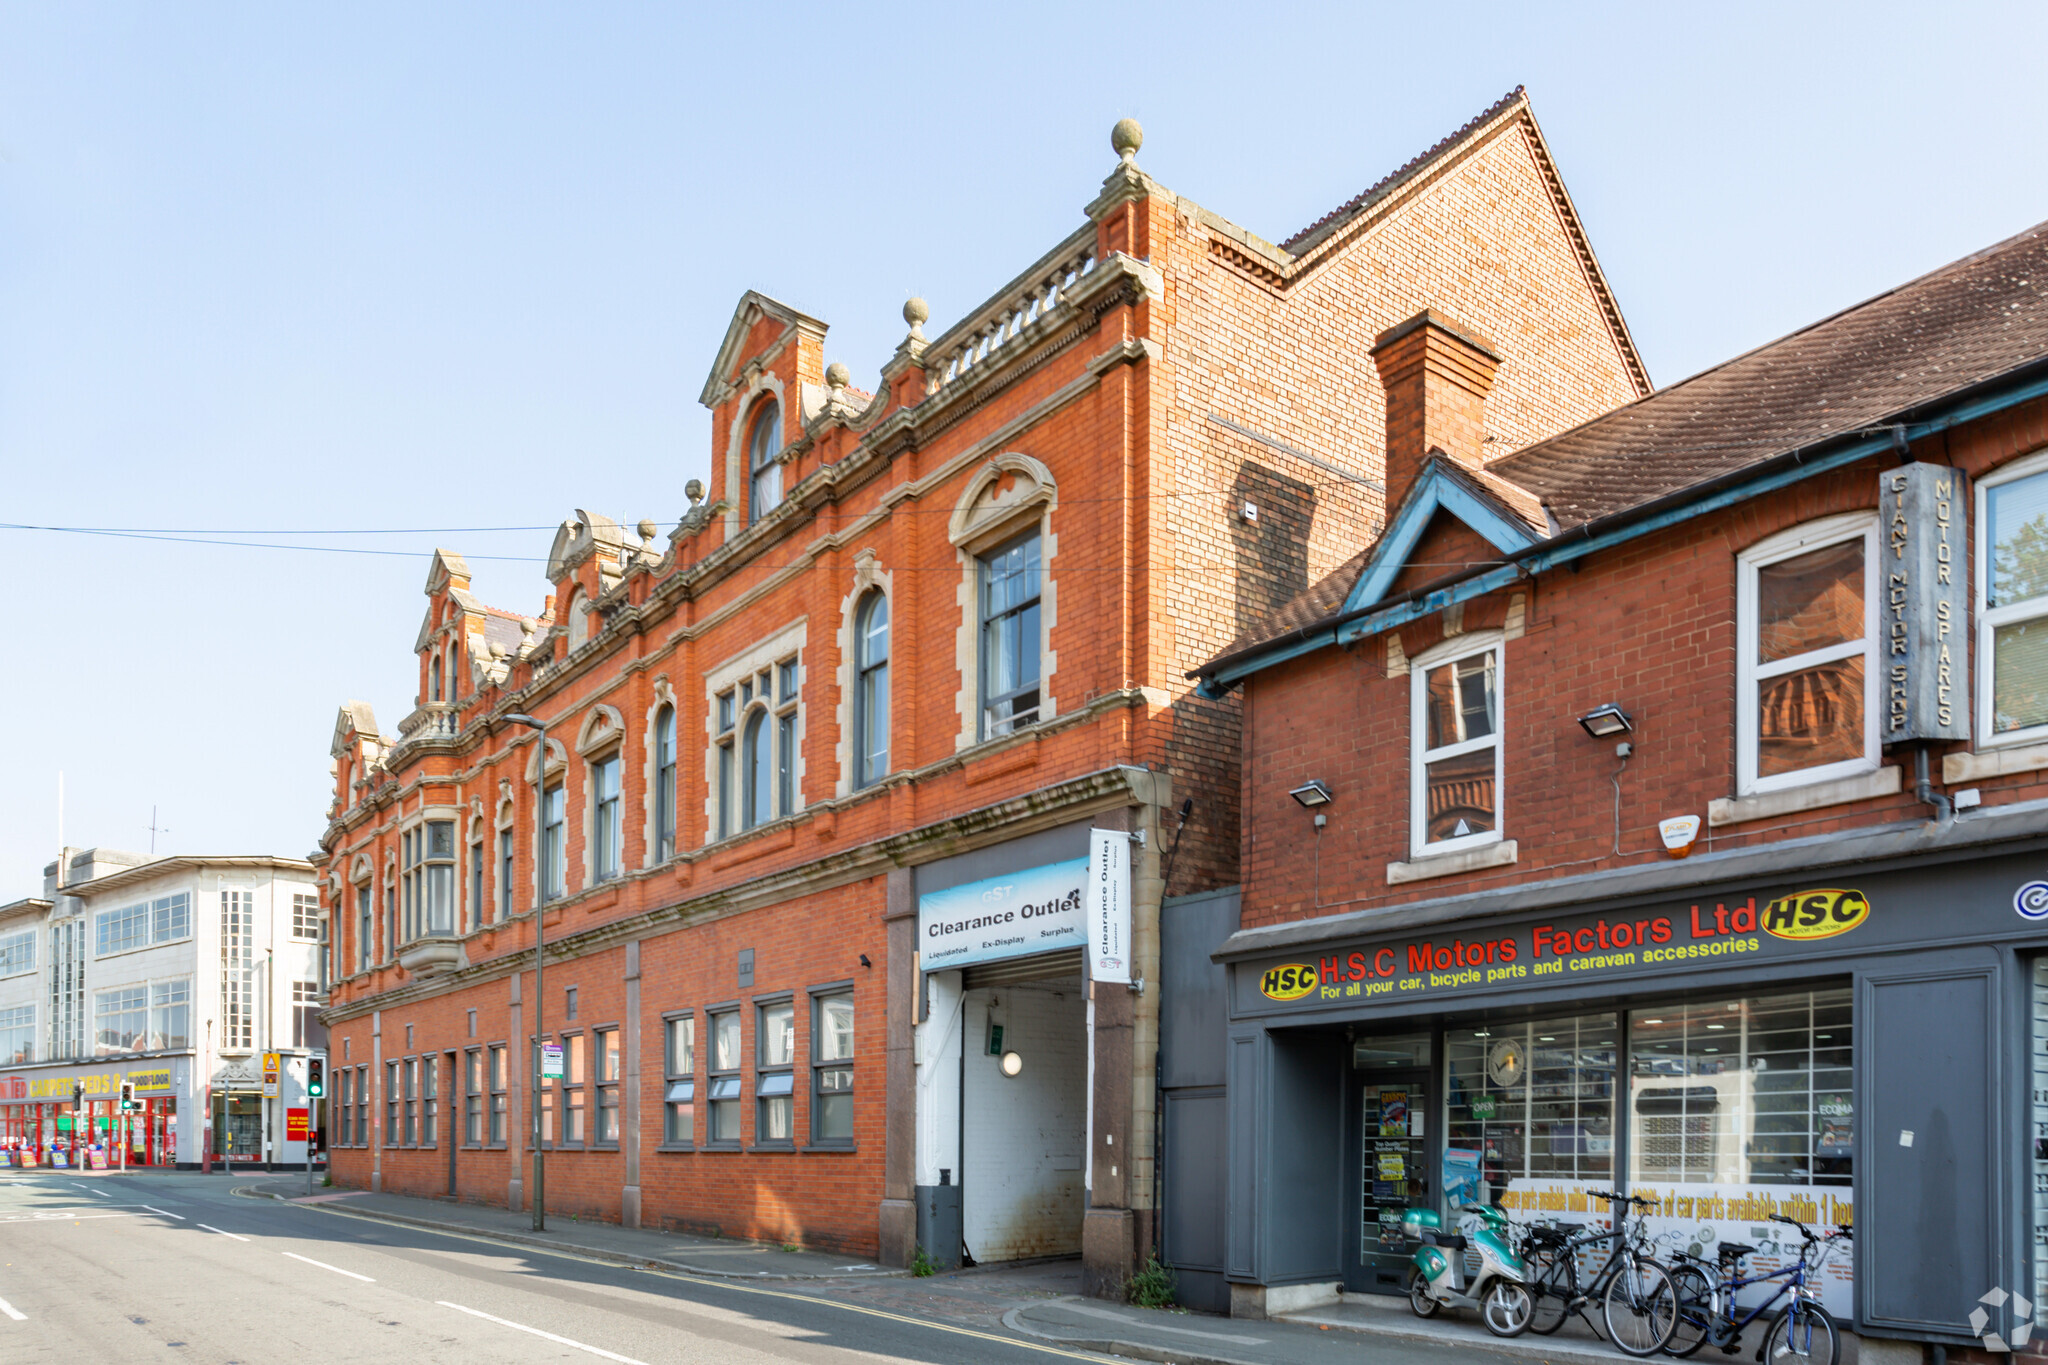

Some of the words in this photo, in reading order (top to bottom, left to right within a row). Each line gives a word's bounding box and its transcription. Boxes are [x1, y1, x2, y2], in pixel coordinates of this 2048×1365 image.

[1891, 474, 1908, 560] GIANT
[1935, 479, 1952, 585] MOTOR
[1889, 570, 1909, 656] MOTOR
[1936, 600, 1952, 727] SPARES
[1890, 665, 1908, 733] SHOP
[1101, 839, 1109, 882] Outlet
[982, 884, 1014, 903] GST
[1767, 891, 1864, 930] HSC
[928, 911, 1015, 938] Clearance
[1020, 896, 1081, 919] Outlet
[928, 946, 968, 960] Liquidated
[982, 935, 1025, 949] Ex-Display
[1040, 925, 1075, 939] Surplus
[1319, 948, 1396, 985] H.S.C
[1407, 939, 1518, 974] Motors
[1532, 917, 1673, 958] Factors
[1690, 897, 1757, 938] Ltd
[1264, 966, 1315, 993] HSC
[1320, 986, 1341, 999] For
[1346, 982, 1361, 996] all
[1366, 980, 1394, 997] your
[1400, 976, 1425, 991] car,
[1430, 968, 1482, 987] bicycle
[1487, 963, 1527, 983] parts
[1533, 957, 1563, 975] and
[1569, 952, 1636, 971] caravan
[1642, 937, 1760, 963] accessories
[30, 1077, 74, 1098] CARPETS
[112, 1073, 121, 1094] &
[1473, 1101, 1495, 1113] OPEN
[1663, 1188, 1675, 1218] of
[1676, 1197, 1694, 1219] car
[1696, 1192, 1725, 1222] parts
[1727, 1191, 1778, 1223] available
[1780, 1193, 1818, 1225] within
[1821, 1193, 1828, 1225] 1
